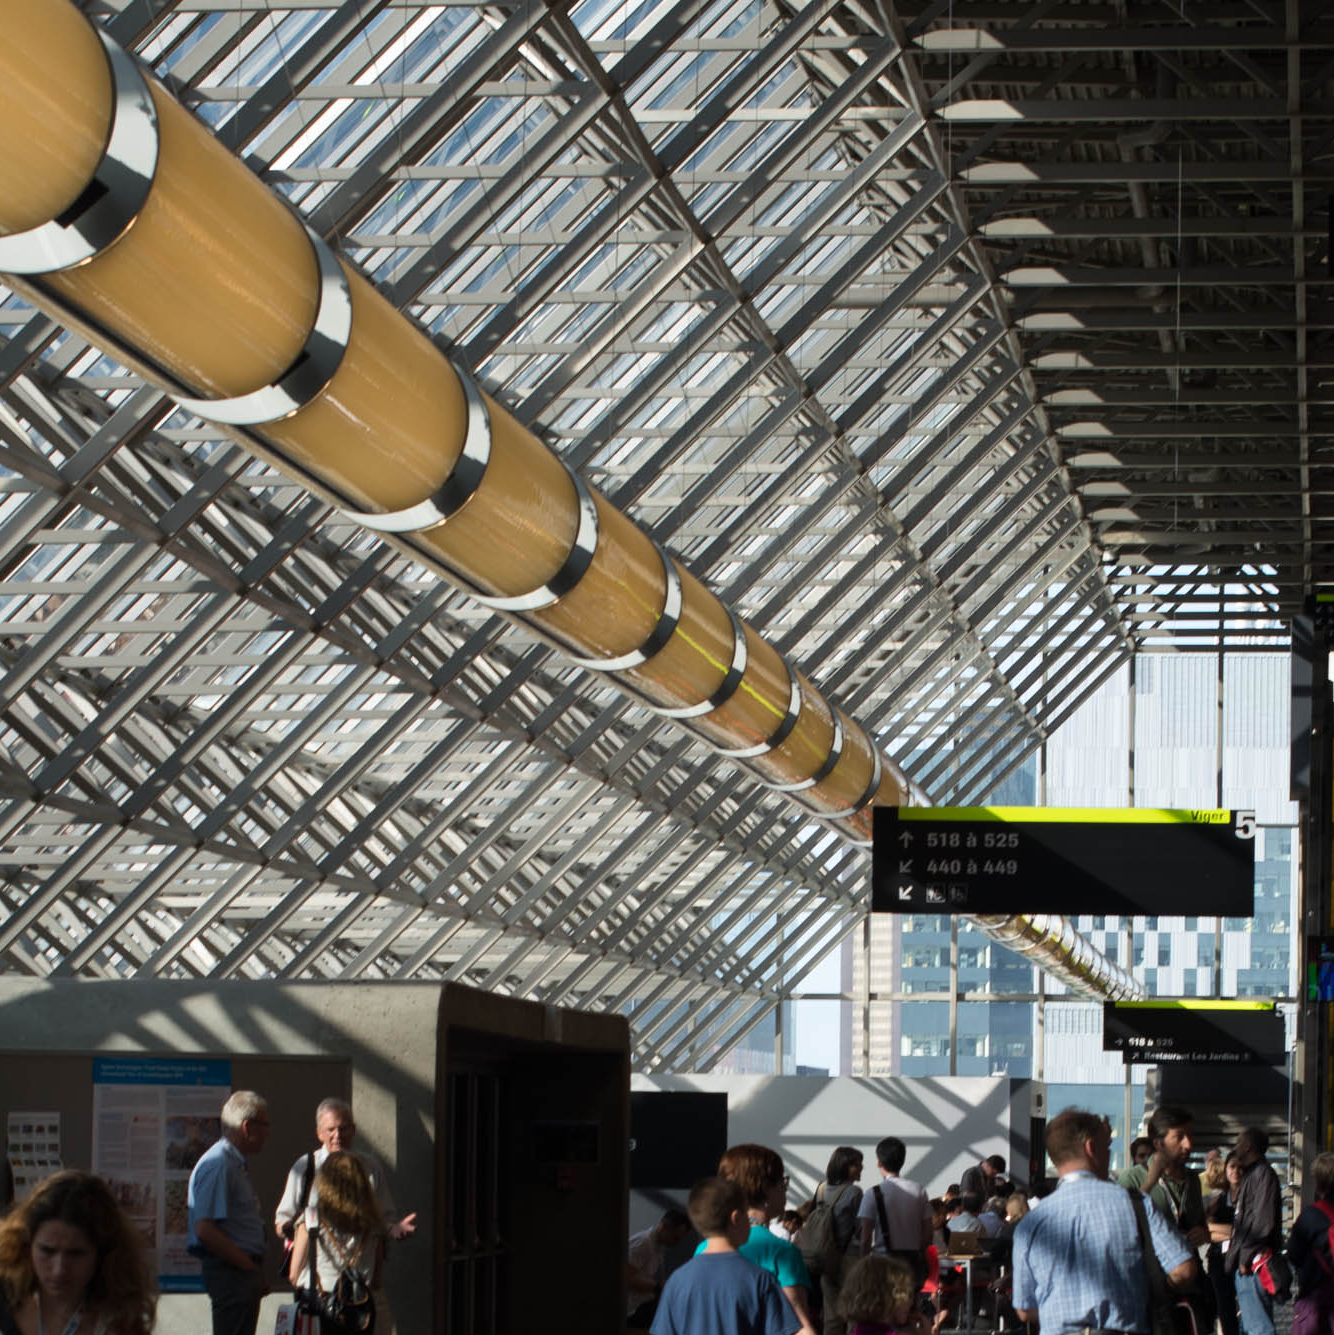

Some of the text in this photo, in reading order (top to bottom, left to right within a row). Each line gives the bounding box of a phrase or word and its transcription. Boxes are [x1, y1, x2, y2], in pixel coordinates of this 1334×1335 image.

[1190, 810, 1255, 840] Viger 5
[926, 831, 1020, 849] 518 à 525
[926, 858, 1019, 876] 440 à 449
